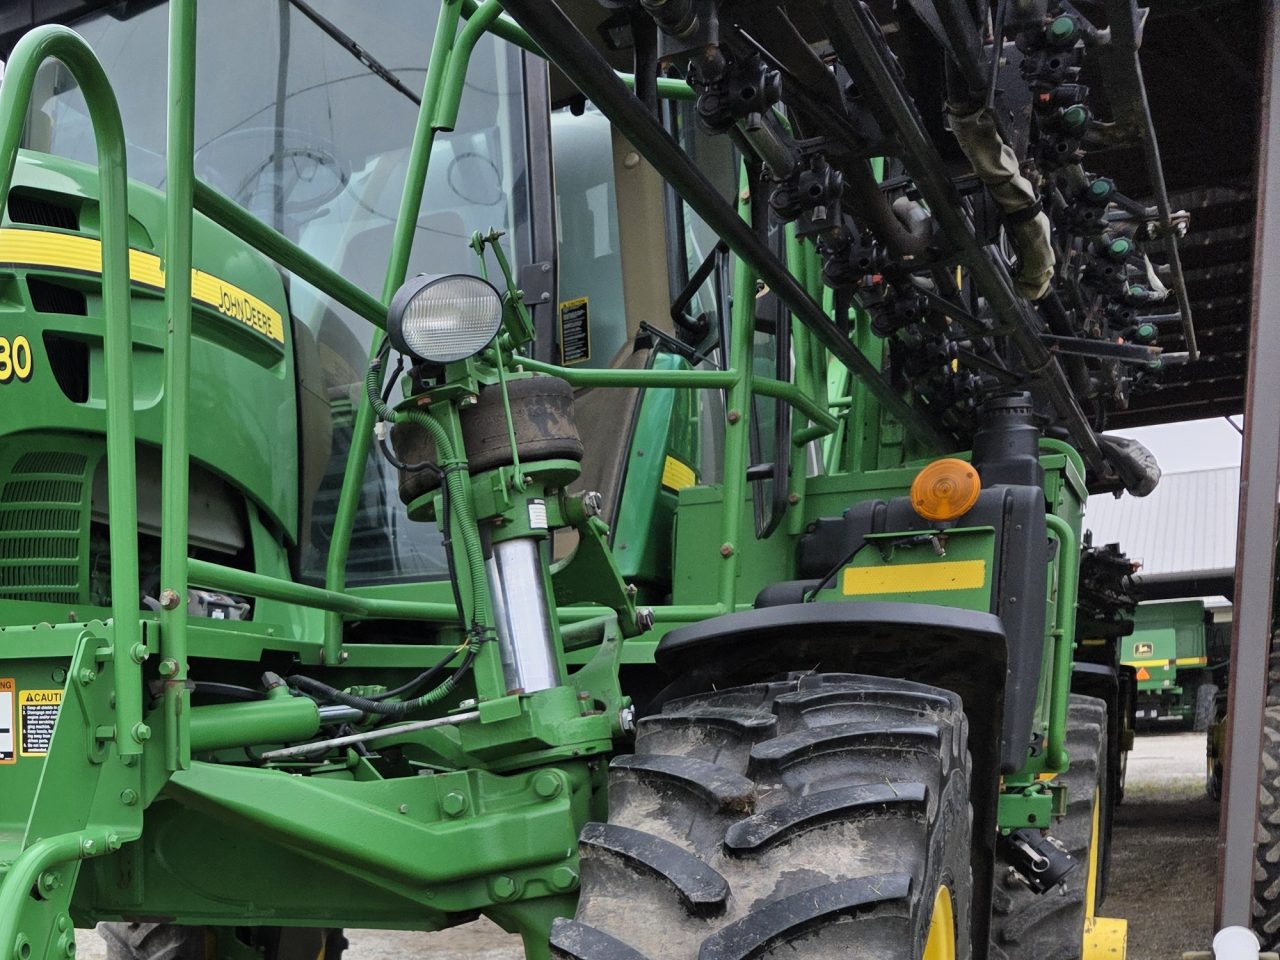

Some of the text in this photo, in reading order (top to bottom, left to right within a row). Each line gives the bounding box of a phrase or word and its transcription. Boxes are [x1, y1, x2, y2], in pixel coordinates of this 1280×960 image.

[219, 286, 273, 335] JOHN DEERE
[34, 693, 62, 702] CAUTI
